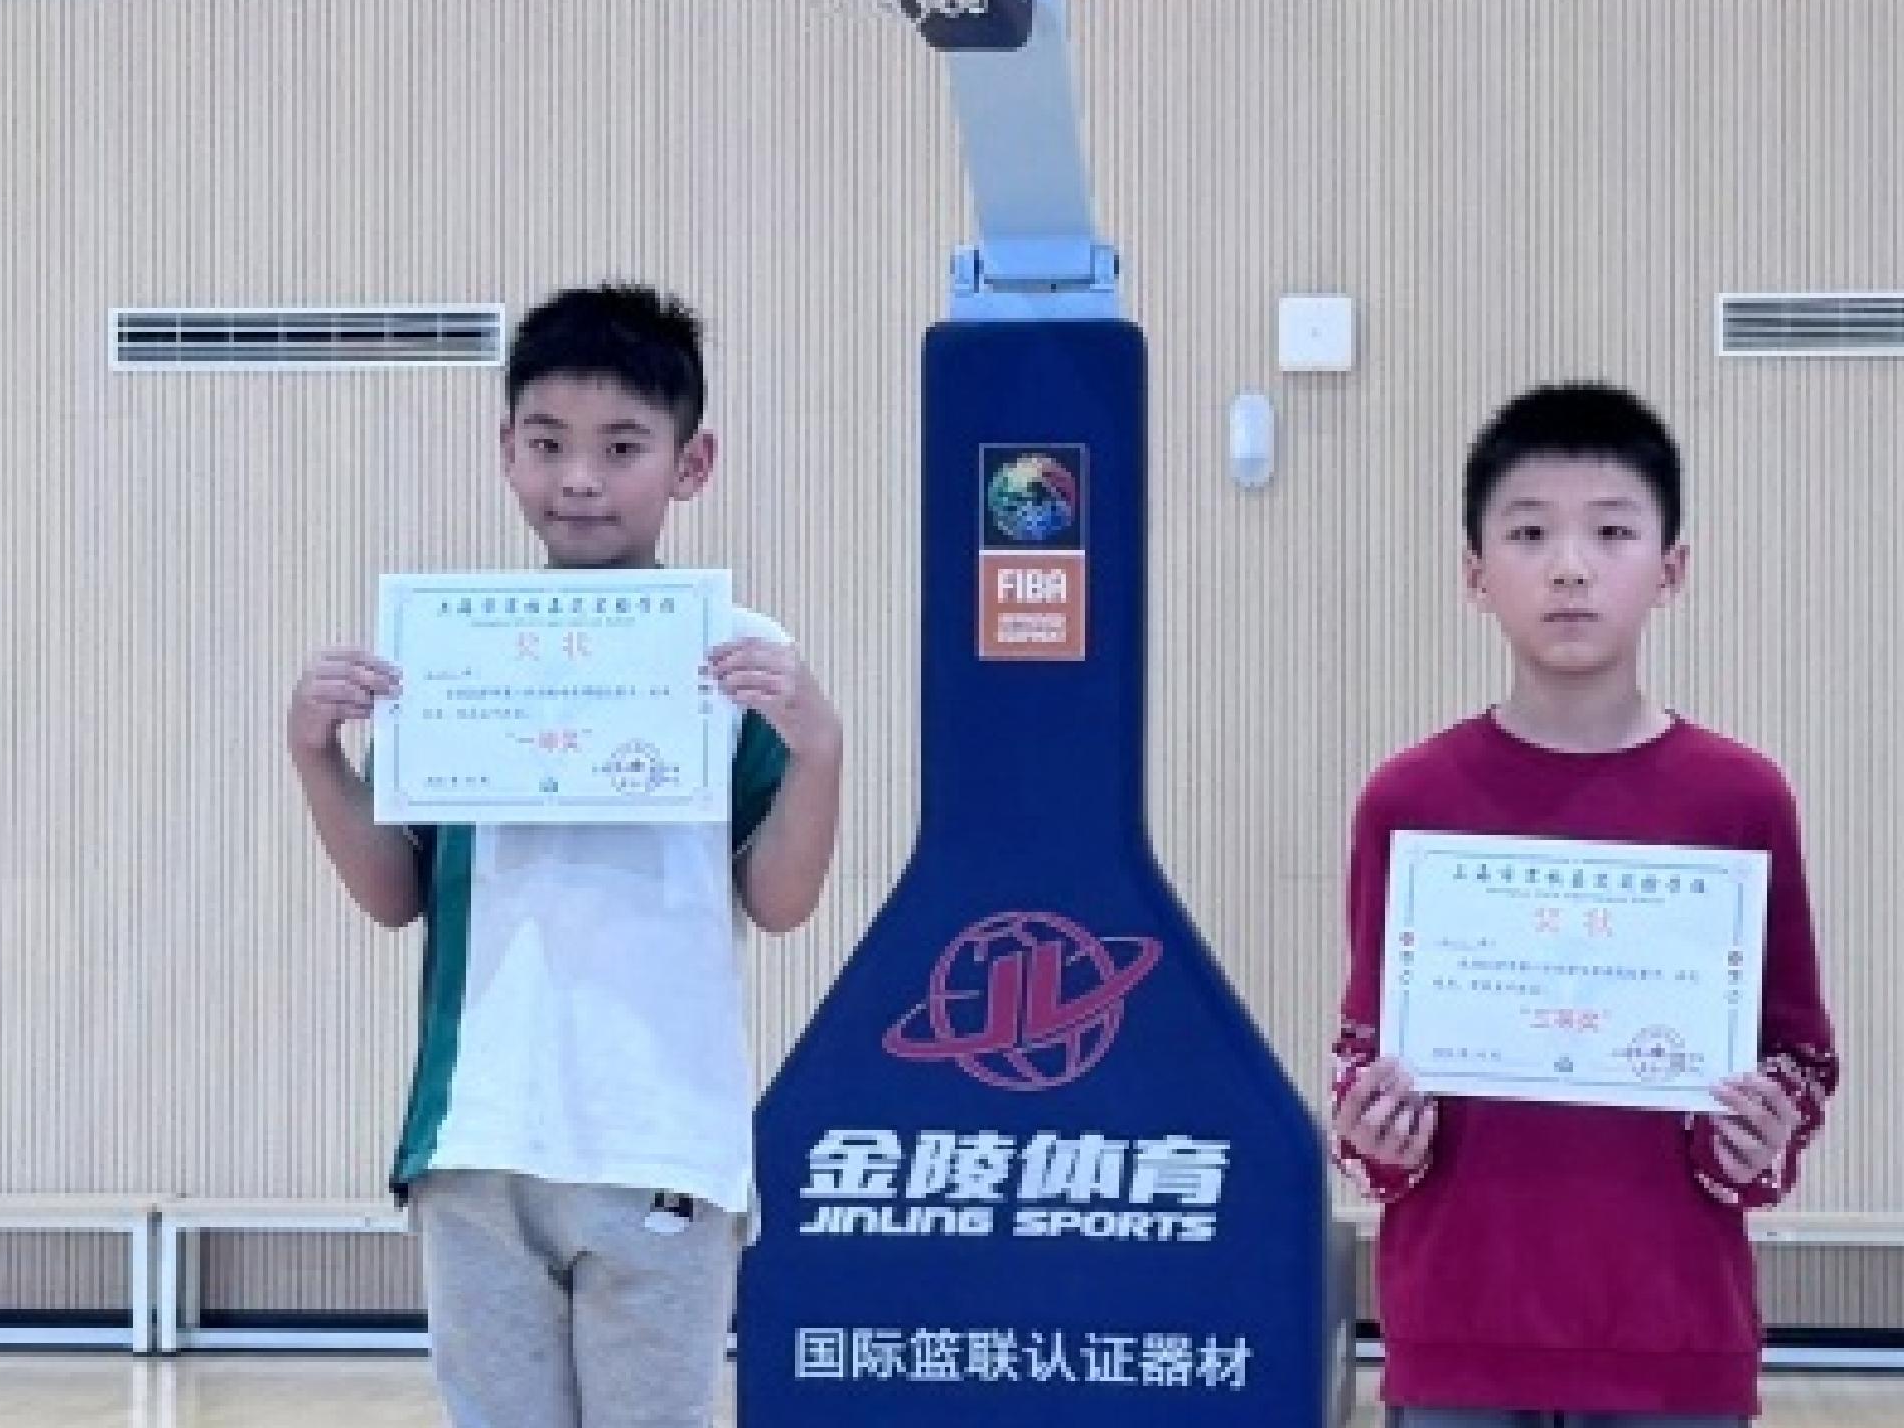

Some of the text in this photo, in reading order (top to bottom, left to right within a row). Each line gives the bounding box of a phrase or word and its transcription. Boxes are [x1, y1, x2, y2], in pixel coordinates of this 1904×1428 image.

[996, 568, 1068, 604] FIBA
[799, 1129, 1231, 1204] 金陵体育
[1013, 1210, 1217, 1242] SPORTS
[794, 1327, 1254, 1390] 国际篮联认证器材
